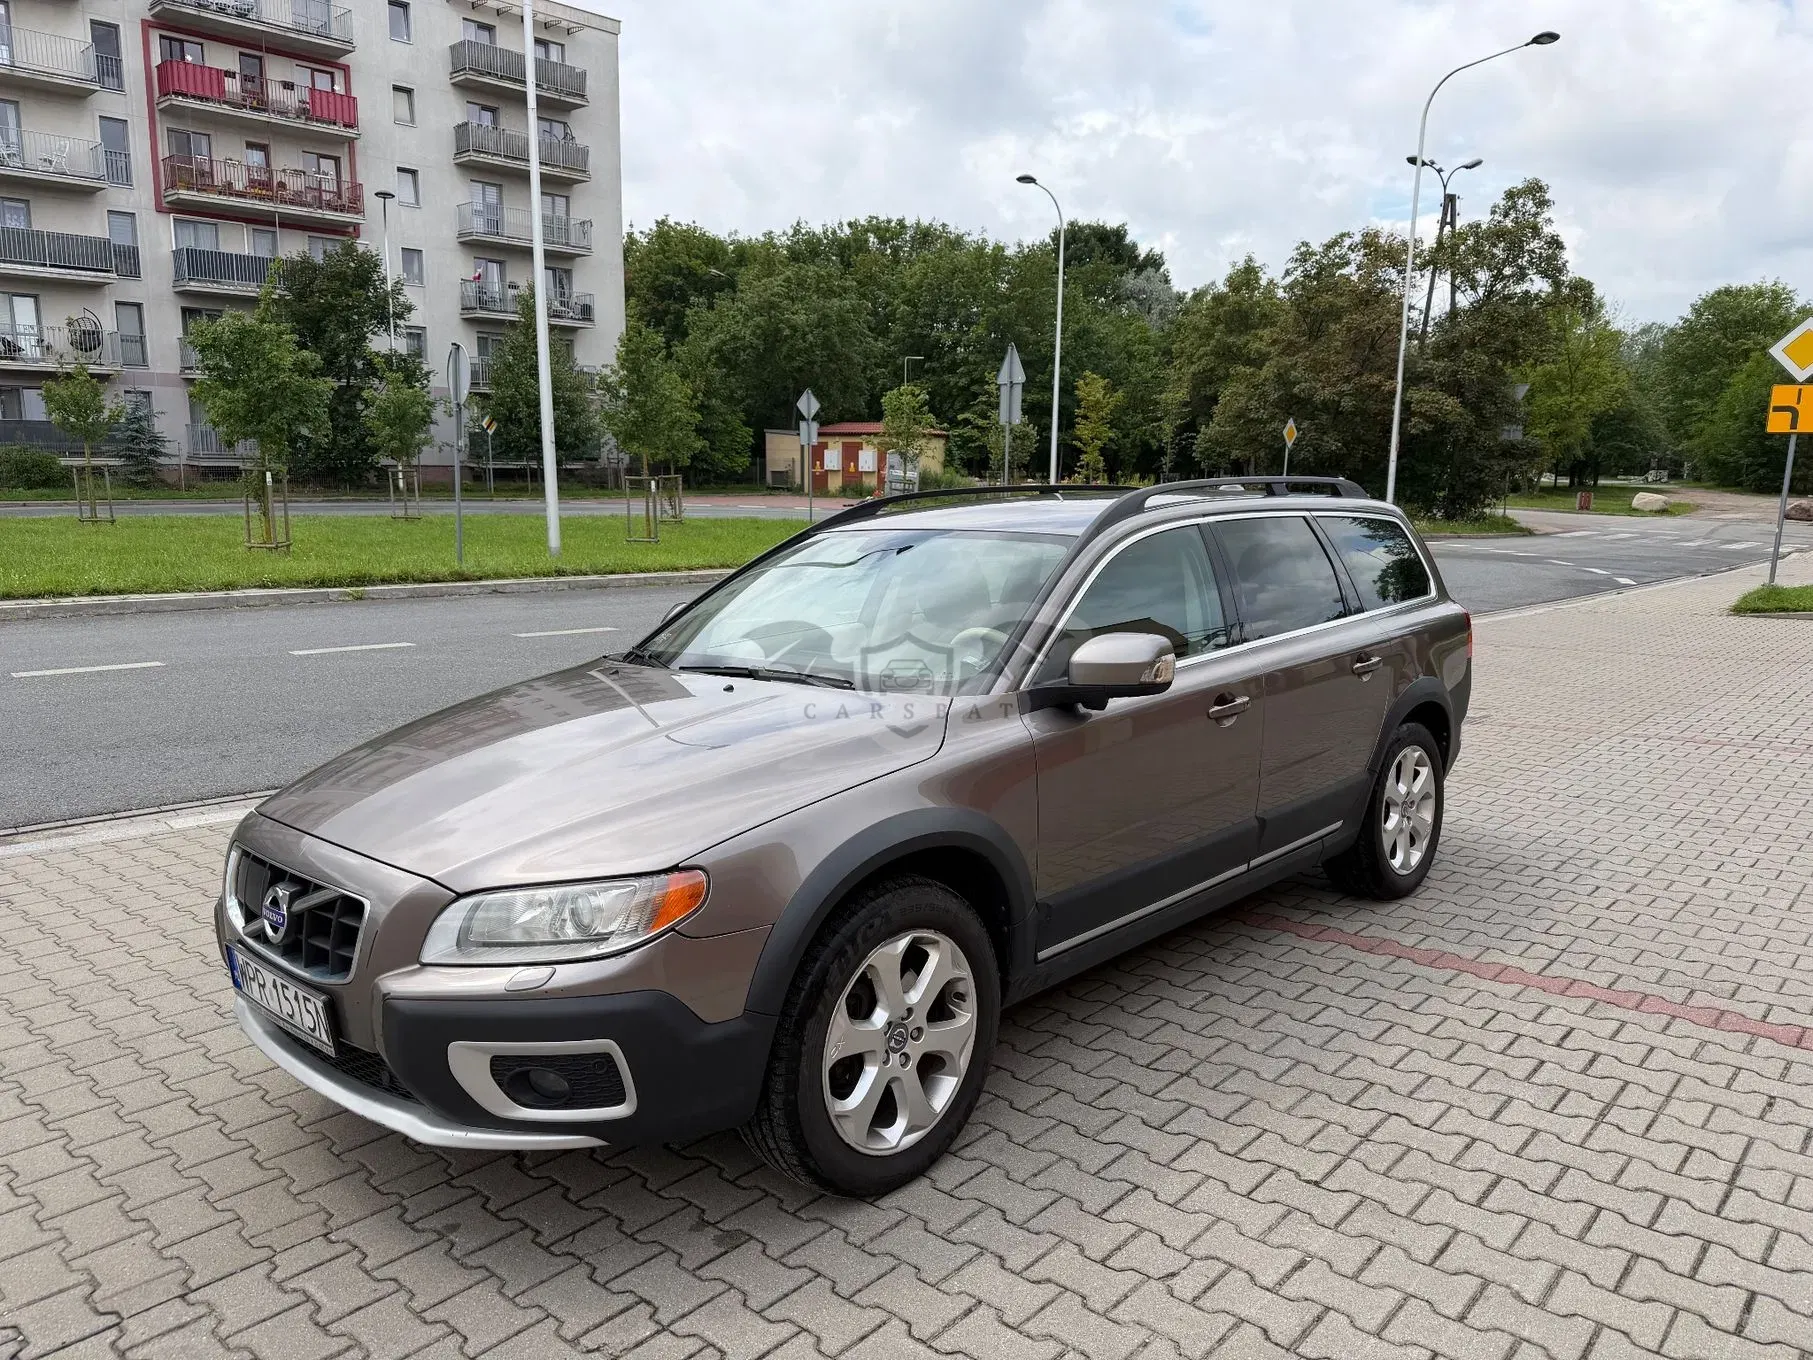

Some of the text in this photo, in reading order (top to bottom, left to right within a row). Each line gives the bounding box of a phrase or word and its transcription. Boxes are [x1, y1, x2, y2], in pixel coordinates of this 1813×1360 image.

[262, 909, 283, 924] VOLVO
[240, 957, 271, 1007] WPR
[272, 977, 332, 1043] 1515N
